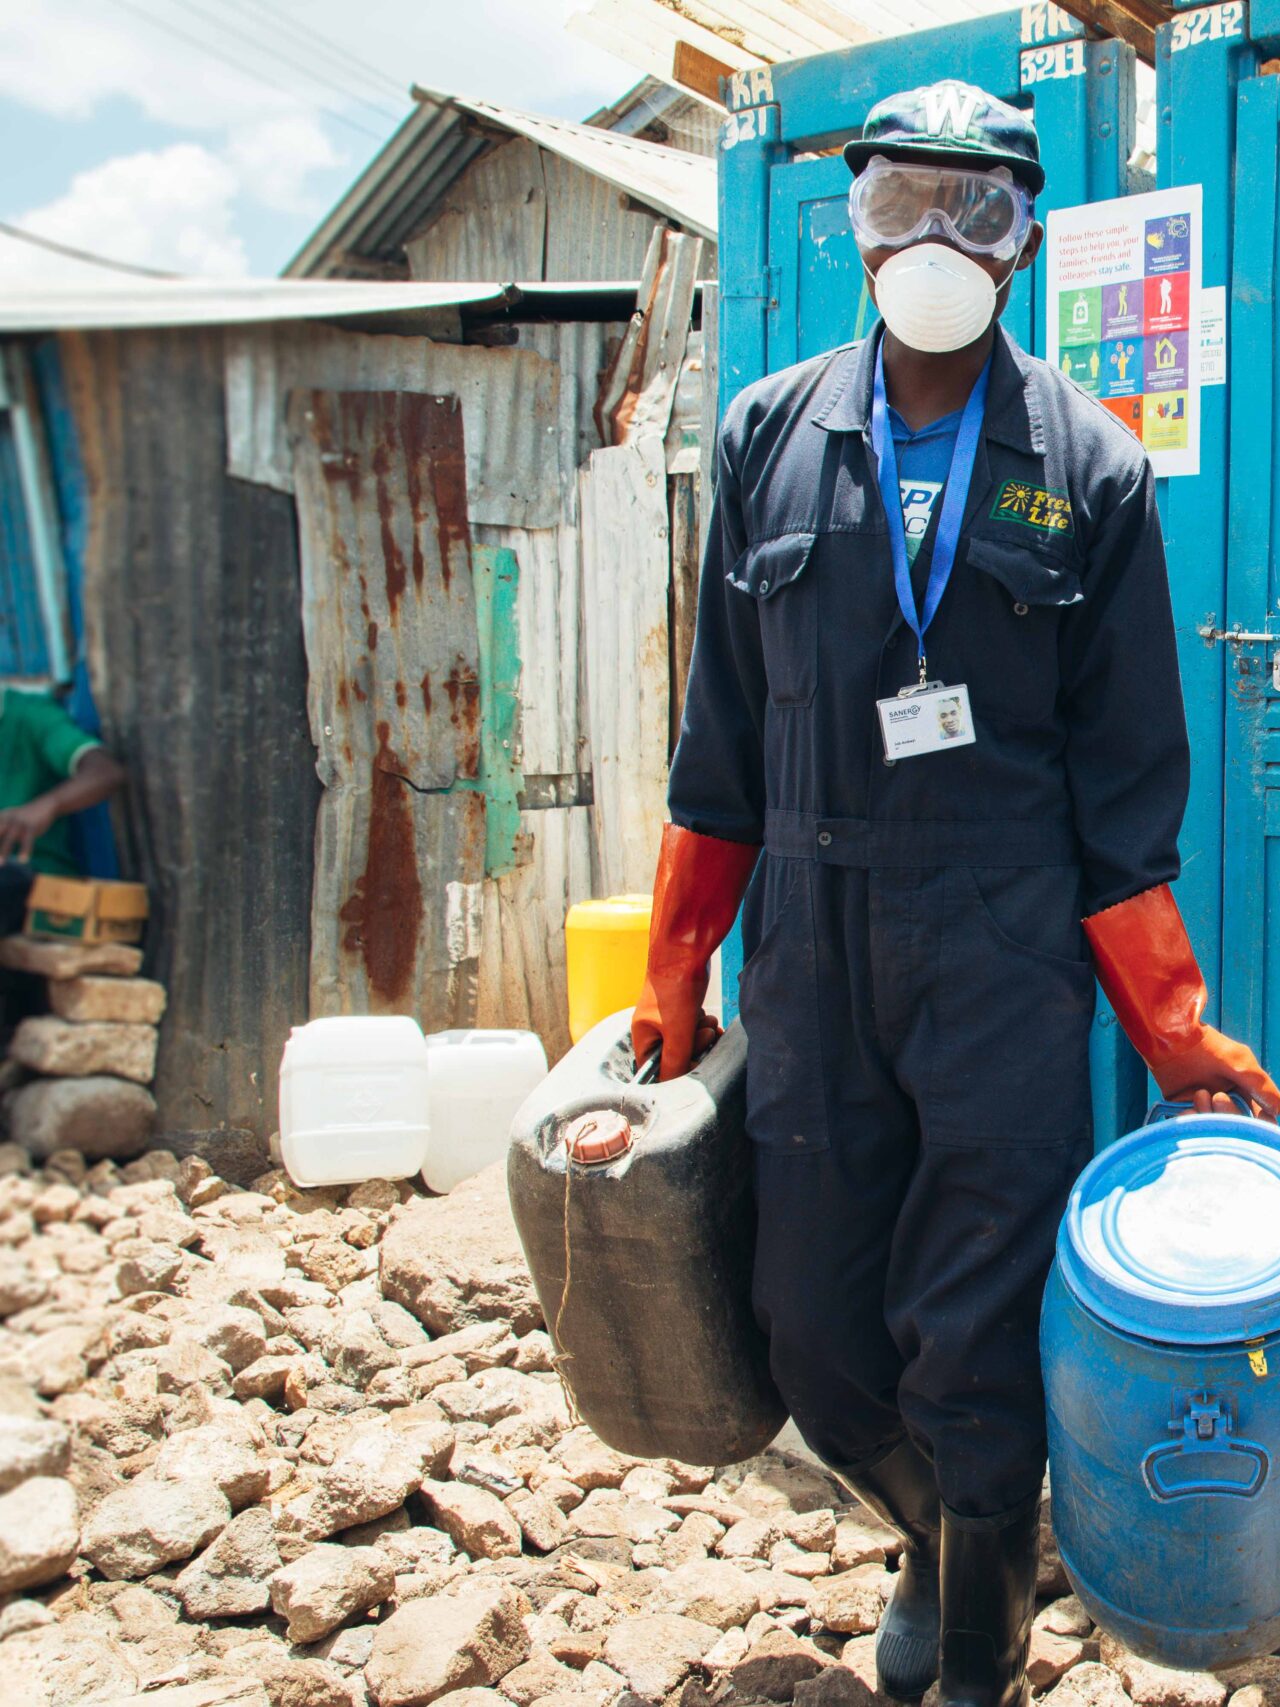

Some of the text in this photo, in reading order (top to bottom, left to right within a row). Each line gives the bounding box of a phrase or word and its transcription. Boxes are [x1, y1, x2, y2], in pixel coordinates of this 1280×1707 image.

[920, 84, 981, 139] W
[1058, 224, 1130, 244] Follow these simple
[1058, 246, 1079, 257] steps
[1080, 245, 1088, 254] to
[1089, 240, 1106, 251] help
[1122, 235, 1139, 247] your
[1091, 251, 1117, 263] friends
[1117, 248, 1132, 260] and
[1058, 262, 1132, 282] colleagues stay safe.
[1033, 490, 1072, 512] Fres
[1028, 506, 1069, 529] Life
